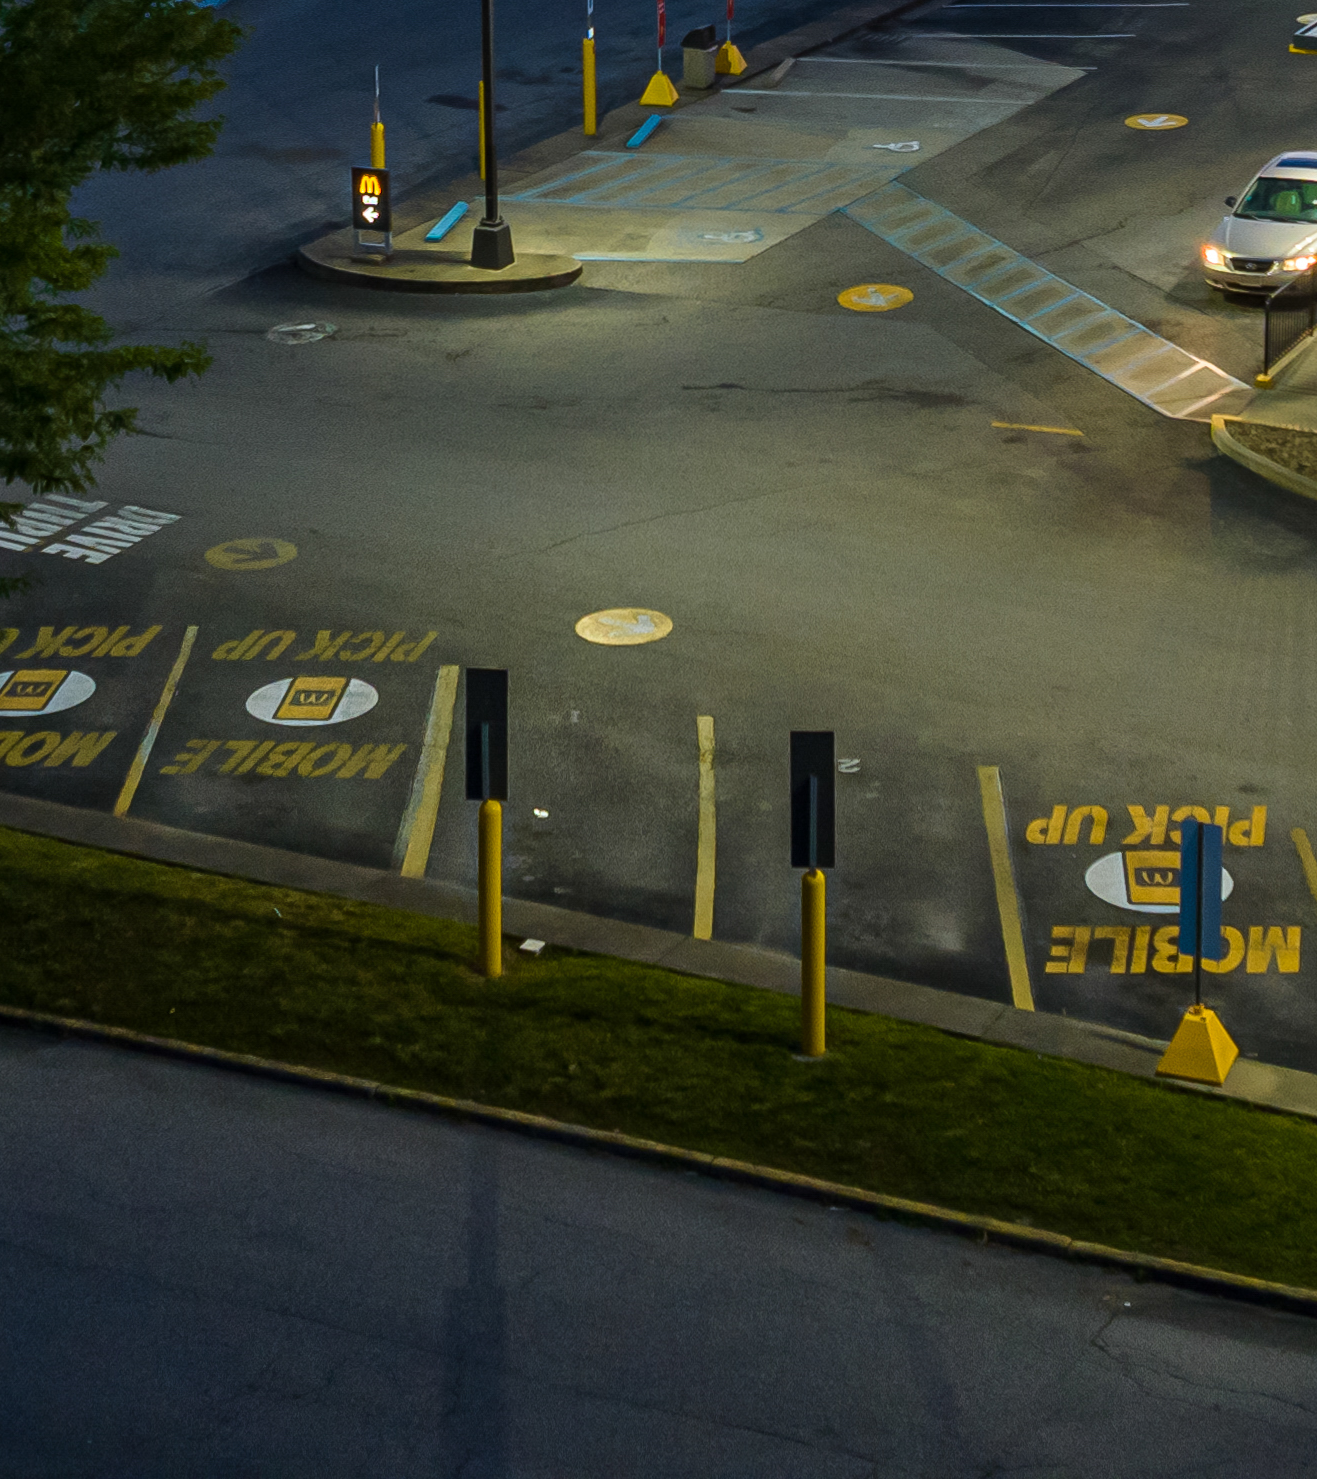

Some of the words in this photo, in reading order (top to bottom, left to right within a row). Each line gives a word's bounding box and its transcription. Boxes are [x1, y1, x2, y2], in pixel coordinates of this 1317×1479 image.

[40, 505, 183, 565] DRIVE
[14, 625, 163, 660] PICK
[212, 628, 287, 662] UP
[297, 629, 439, 663] PICK
[160, 739, 407, 780] MOBILE
[1025, 804, 1109, 845] UP
